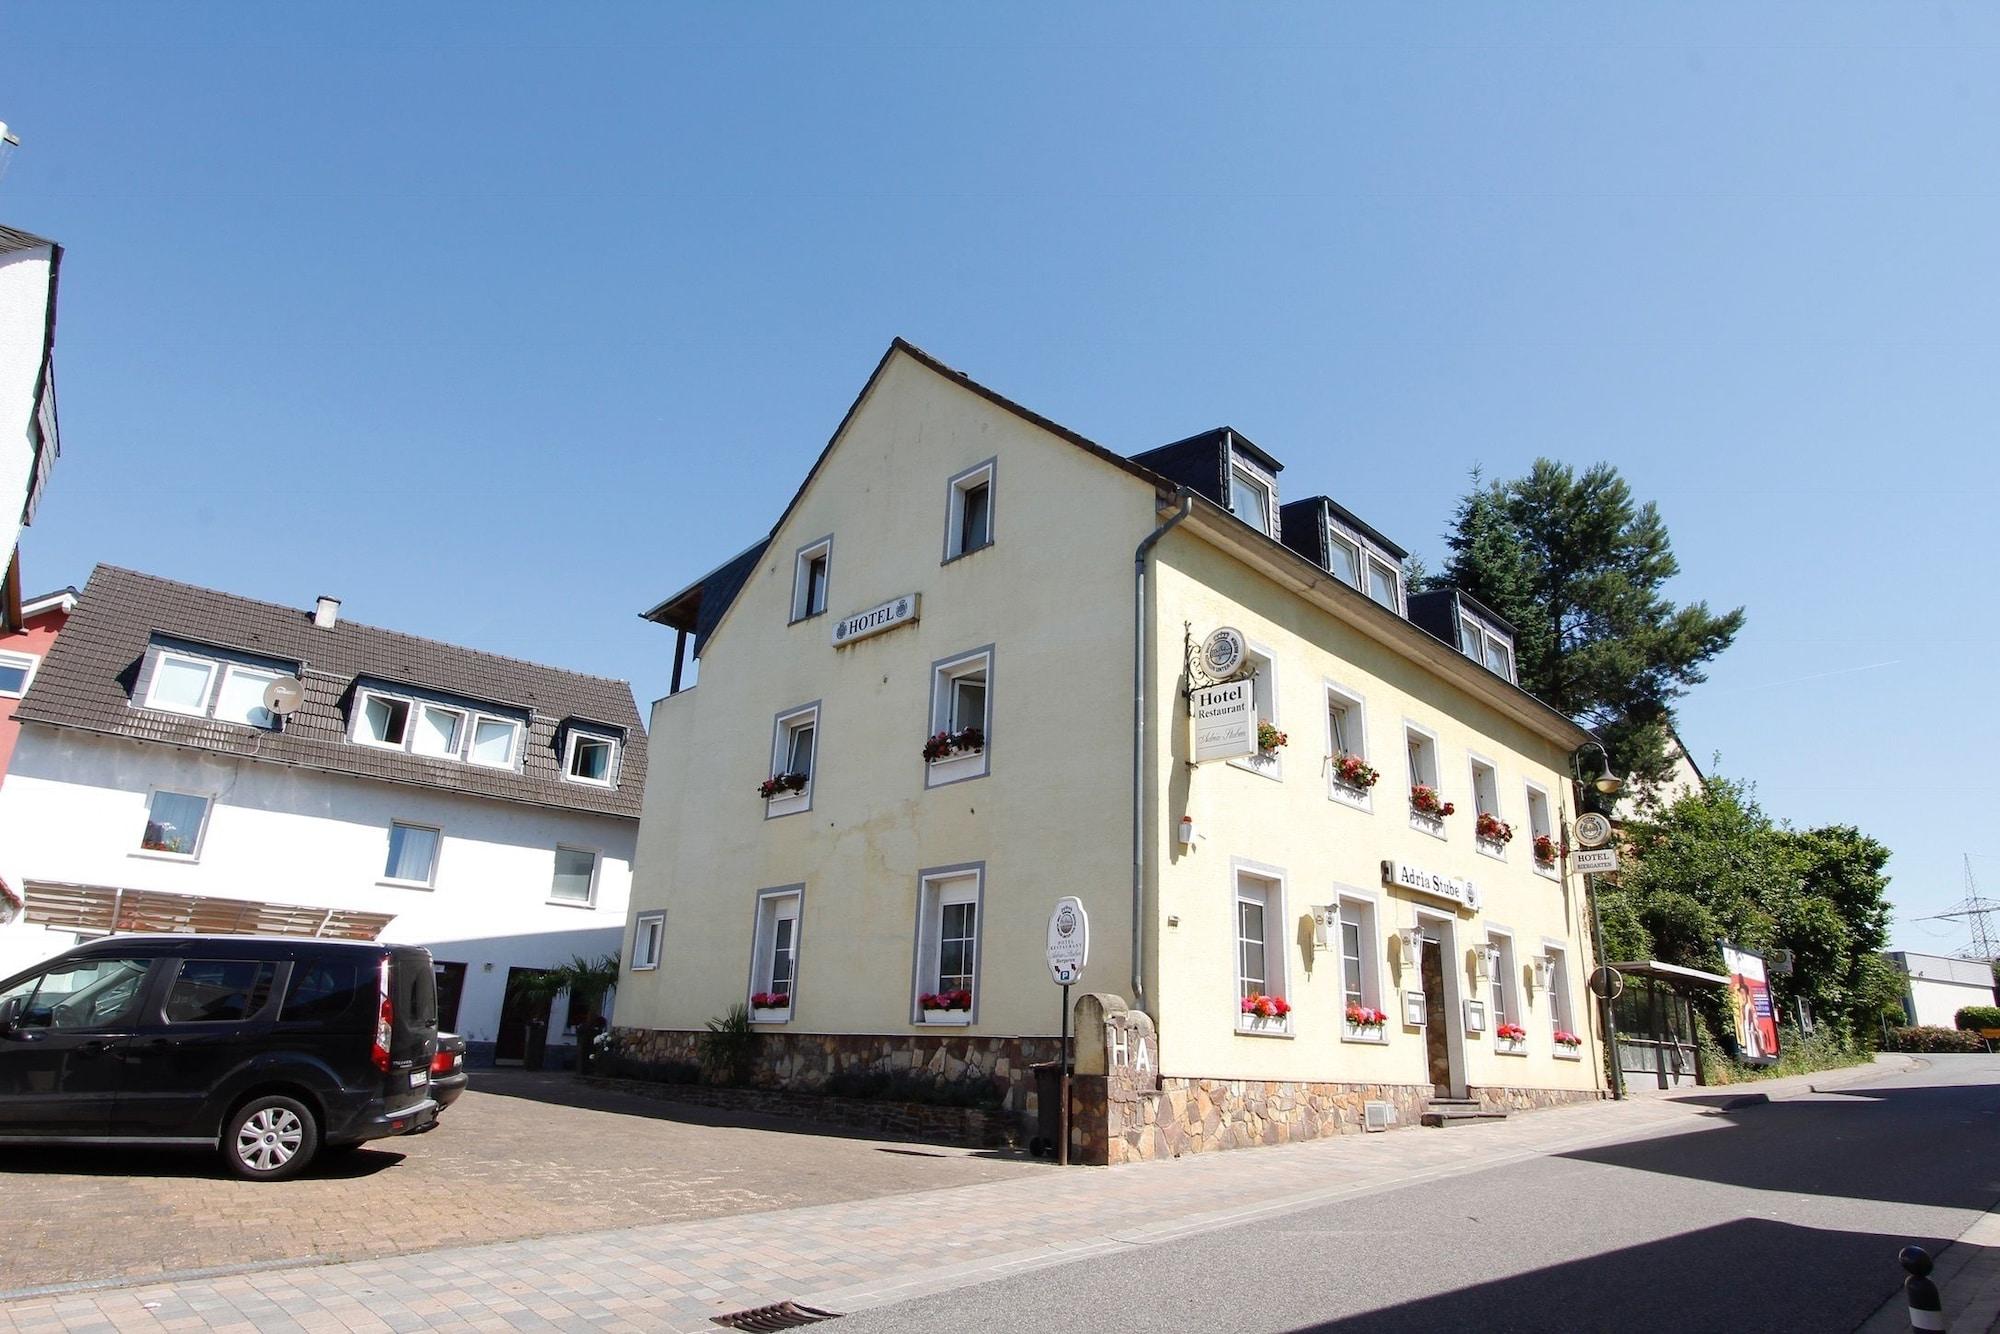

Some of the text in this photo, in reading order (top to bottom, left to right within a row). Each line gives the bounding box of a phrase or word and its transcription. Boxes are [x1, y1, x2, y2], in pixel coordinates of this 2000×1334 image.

[849, 607, 894, 635] HOTEL
[1200, 686, 1242, 706] Hotel
[1199, 703, 1245, 719] Restaurant
[1578, 853, 1609, 862] HOTEL
[1401, 866, 1460, 897] Adria Stube
